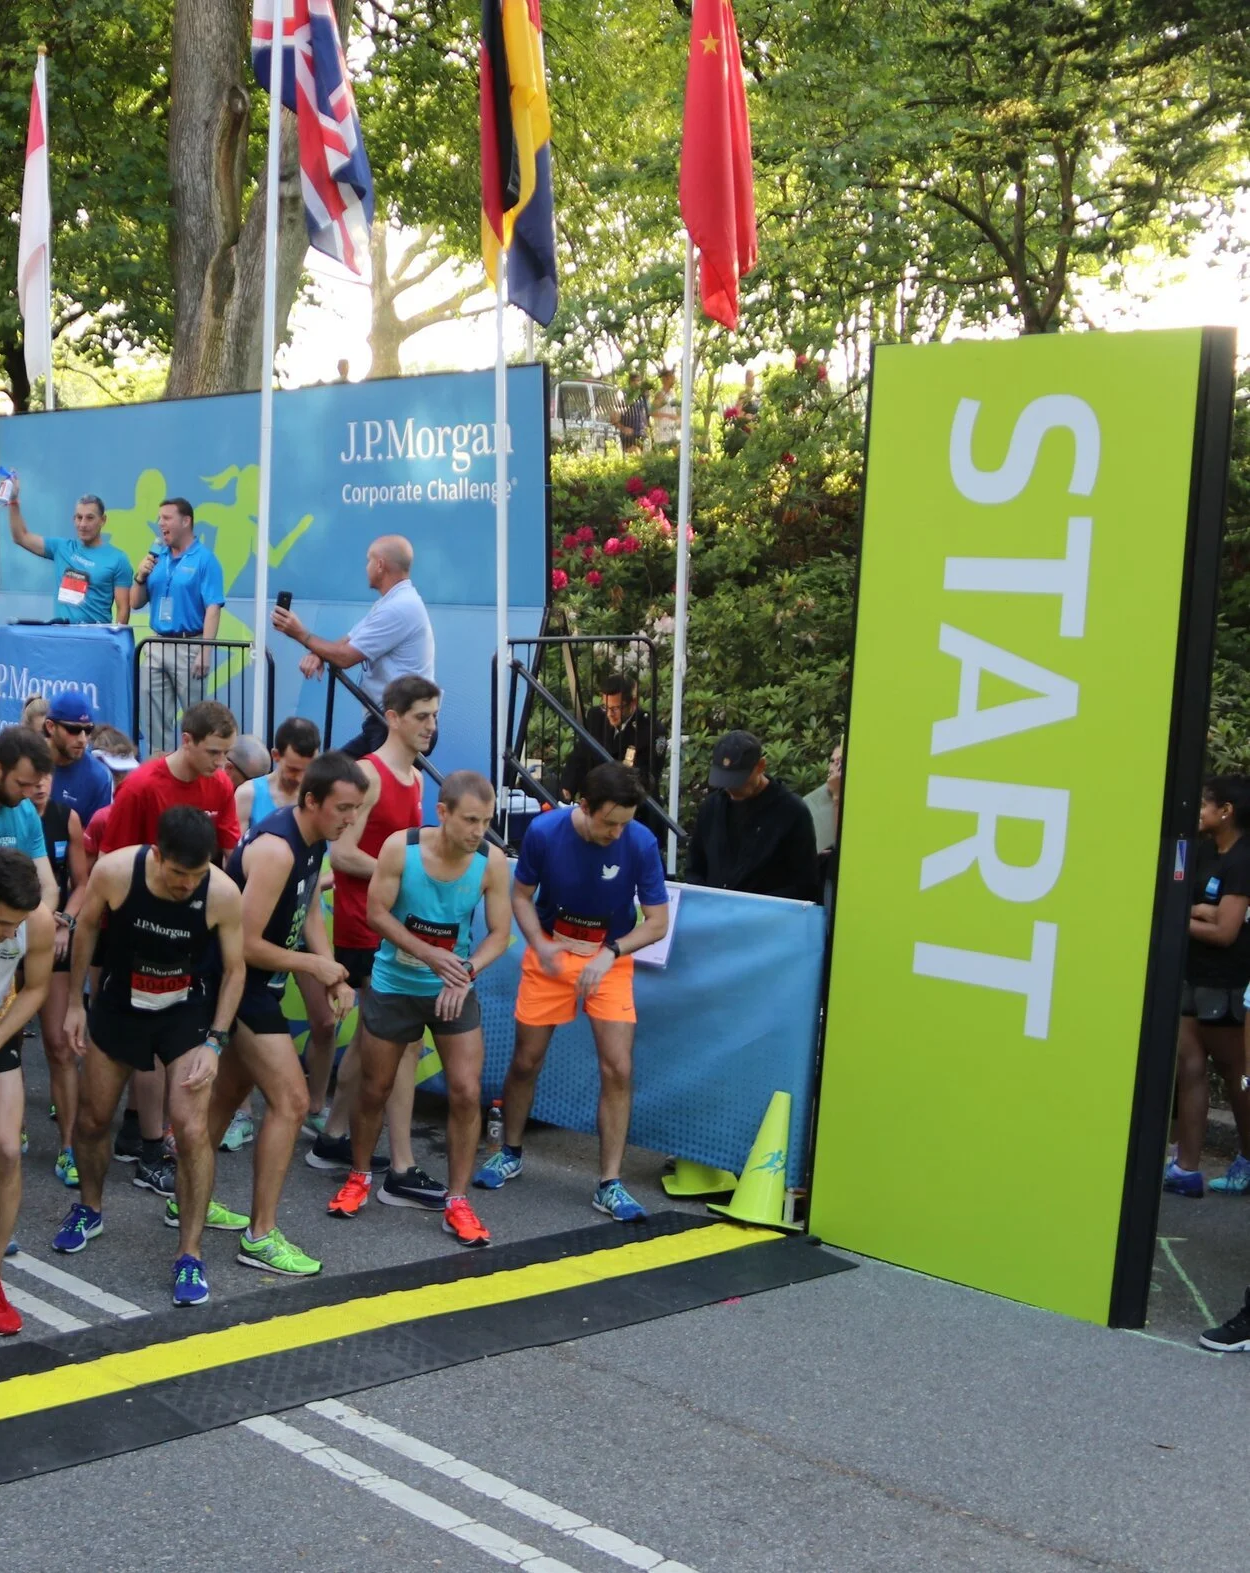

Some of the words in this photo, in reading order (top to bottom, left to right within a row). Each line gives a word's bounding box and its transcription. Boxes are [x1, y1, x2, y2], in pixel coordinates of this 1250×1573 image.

[342, 482, 423, 507] Corporate
[912, 394, 1101, 1041] START
[133, 918, 191, 939] J.P.Morgan
[412, 922, 452, 936] J.P.Morgan
